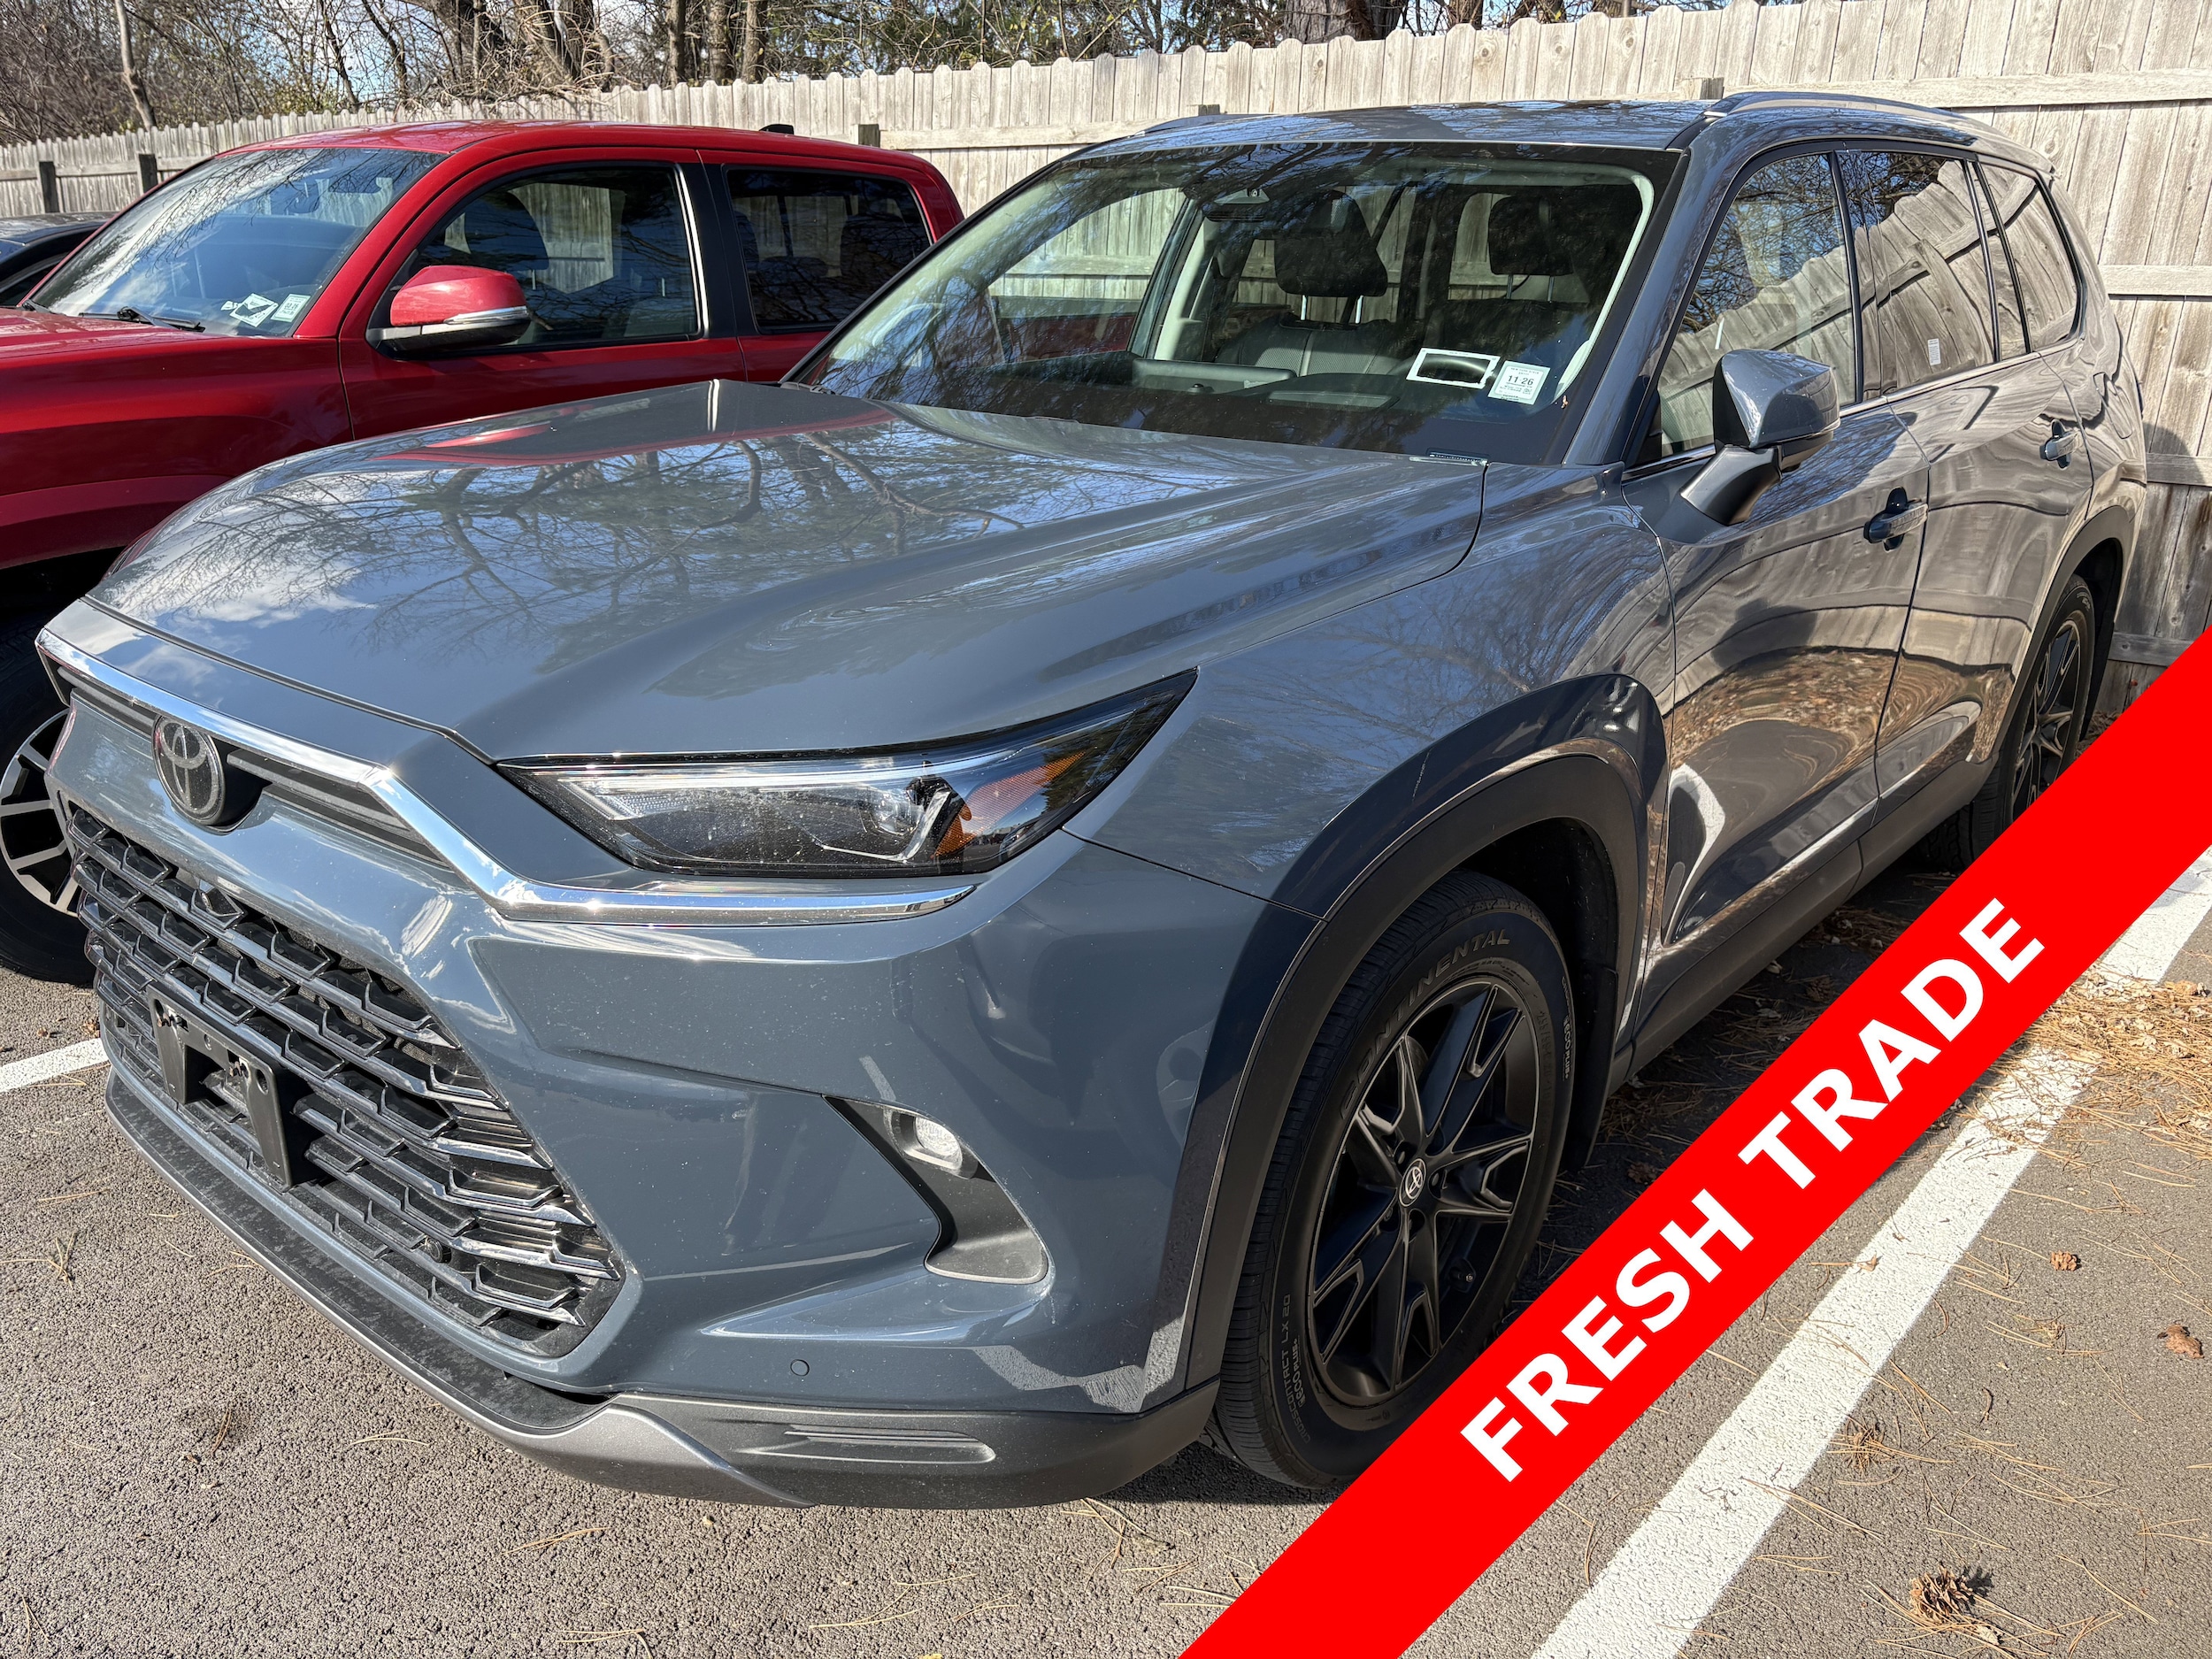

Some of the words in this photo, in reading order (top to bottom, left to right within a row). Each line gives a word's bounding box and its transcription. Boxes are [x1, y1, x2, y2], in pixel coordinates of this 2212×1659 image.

[1340, 928, 1511, 1119] CONTINENTAL
[1281, 1320, 1290, 1343] LX
[1282, 1294, 1292, 1317] 20
[1281, 1349, 1311, 1444] CROSSCONTACT
